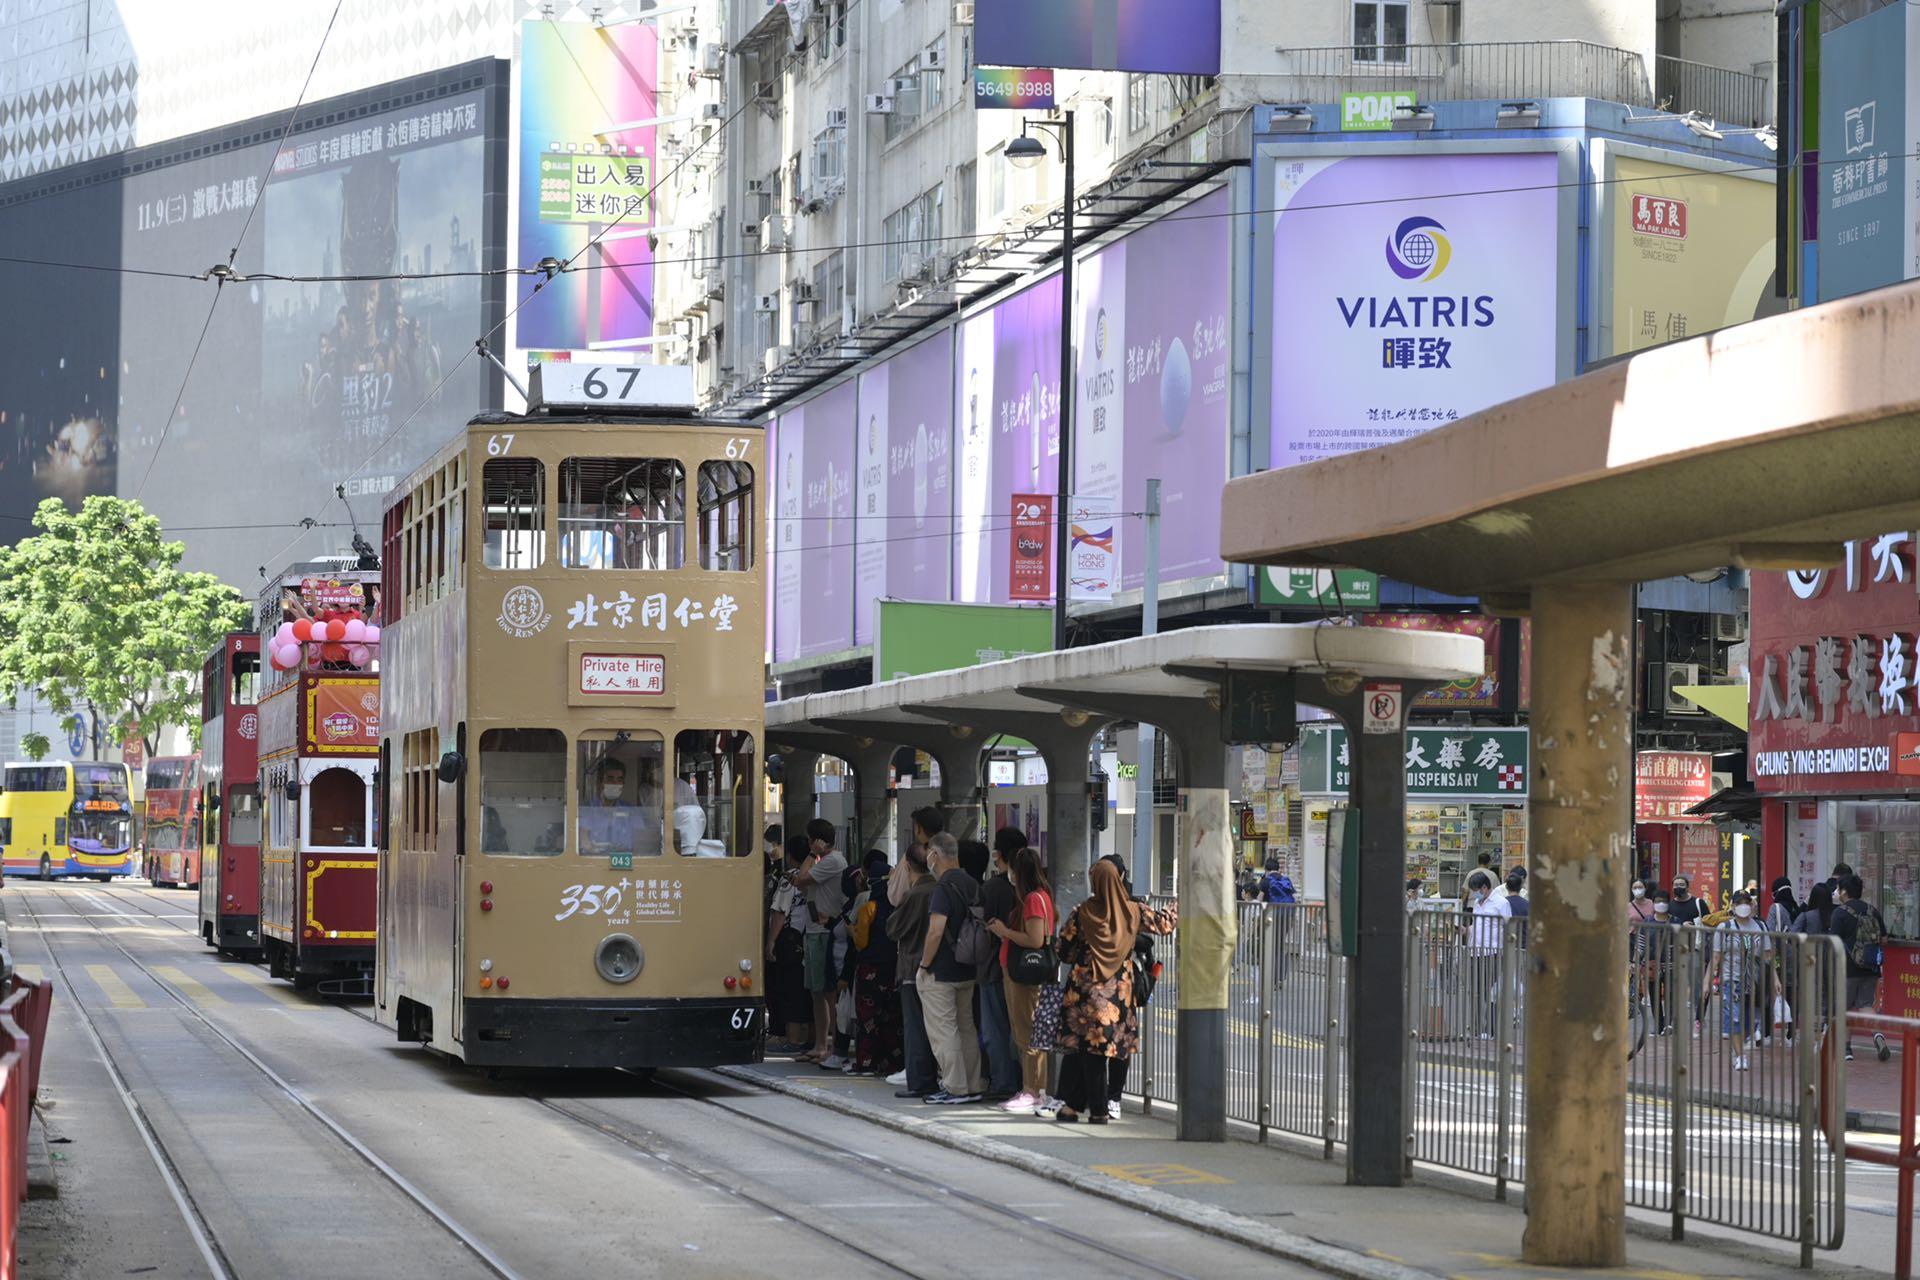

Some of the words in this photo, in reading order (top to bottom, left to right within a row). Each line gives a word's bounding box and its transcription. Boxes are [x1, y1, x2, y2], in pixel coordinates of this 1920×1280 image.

[977, 82, 1014, 96] 5649
[1016, 82, 1052, 96] 6988
[576, 163, 645, 186] 出入易
[575, 193, 645, 216] 迷你倉
[1636, 197, 1681, 227] 馬百良
[1838, 226, 1859, 246] SINCE
[1863, 220, 1880, 240] 1897
[1336, 296, 1495, 328] VIATRIS
[1382, 337, 1452, 369] 暉致
[583, 367, 642, 400] 67
[1085, 369, 1114, 401] VIATRIS
[487, 434, 515, 456] 67
[725, 438, 751, 459] 67
[1078, 553, 1105, 561] HONG
[567, 590, 739, 631] 北京同仁堂
[235, 639, 242, 650] 8
[583, 658, 630, 672] Private
[635, 659, 663, 673] Hire
[585, 676, 661, 690] 私人租用
[1405, 736, 1504, 770] 大藥房
[1755, 751, 1790, 776] CHUNG
[1790, 749, 1815, 774] YING
[1816, 747, 1858, 774] REMINBI
[1859, 746, 1890, 772] EXCH
[1406, 772, 1479, 788] DISPENSARY
[1641, 778, 1661, 788] DIRECT
[1661, 778, 1684, 789] SELLING
[1684, 779, 1706, 790] CENTRE
[611, 855, 631, 866] 043
[607, 918, 631, 927] years
[730, 1008, 755, 1030] 67
